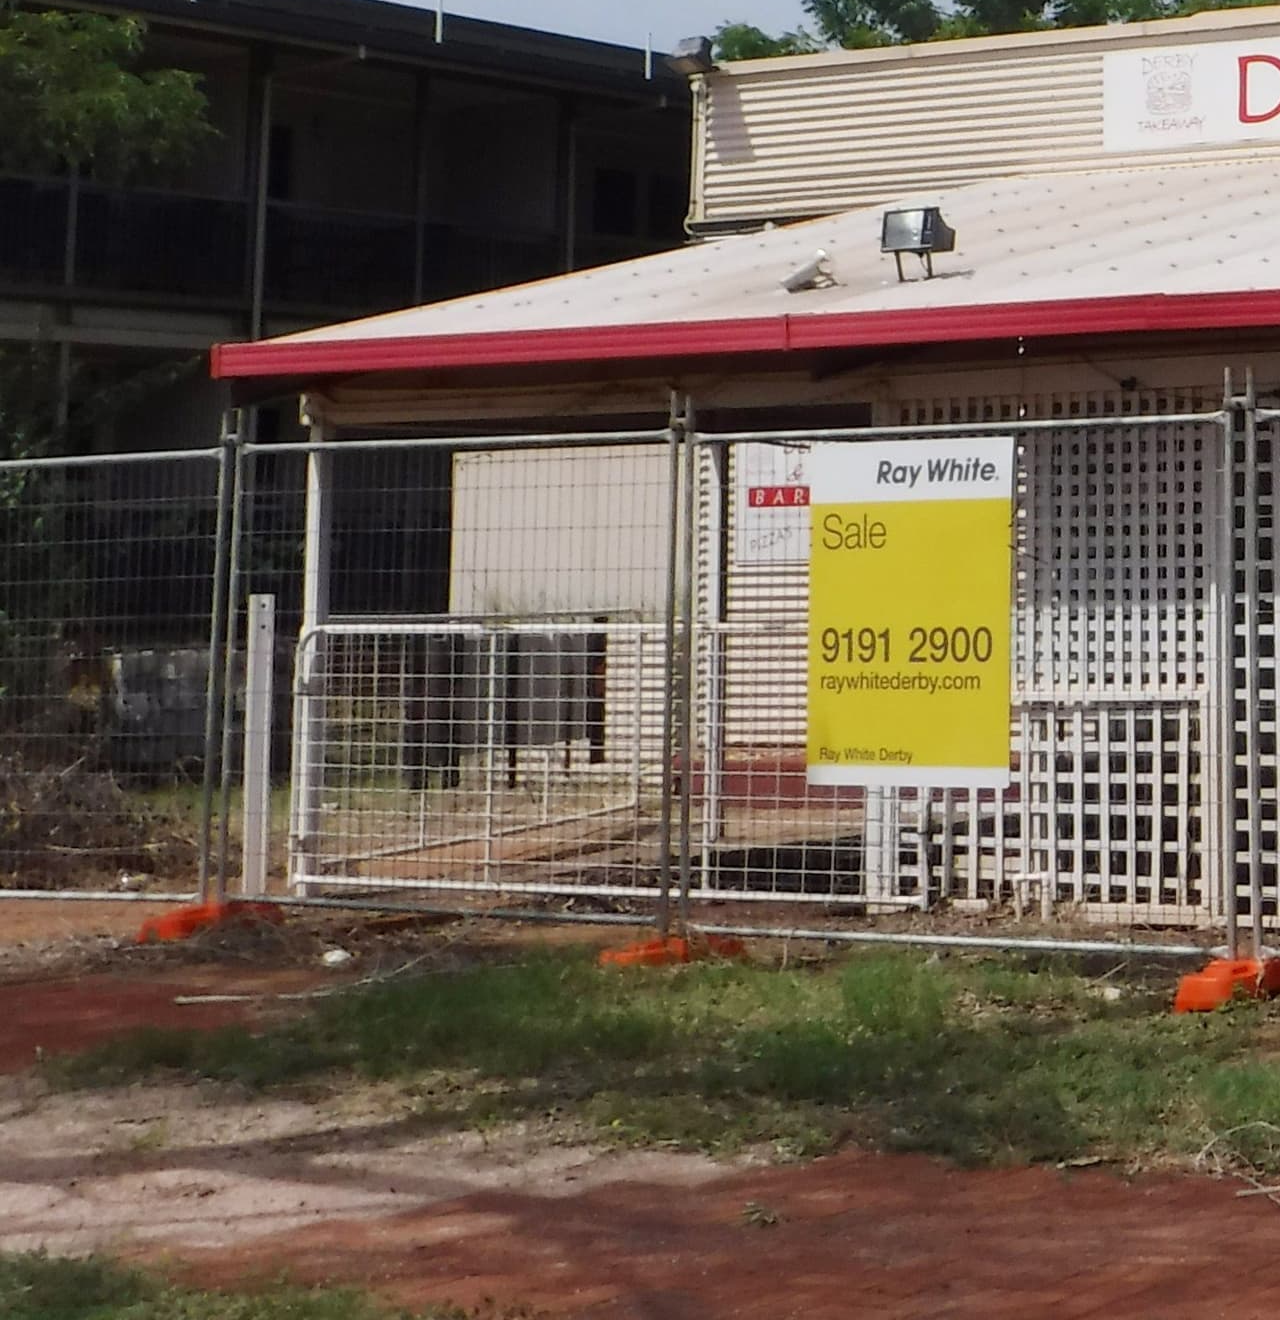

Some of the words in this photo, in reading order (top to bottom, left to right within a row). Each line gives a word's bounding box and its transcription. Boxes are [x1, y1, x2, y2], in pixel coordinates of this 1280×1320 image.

[1136, 114, 1207, 133] TAKEAWAY
[876, 460, 923, 489] Ray
[822, 512, 887, 551] Sale
[821, 626, 891, 663] 9191
[908, 626, 993, 663] 2900
[819, 671, 981, 695] raywhitederby.com
[819, 746, 841, 764] Ray
[843, 747, 876, 761] White
[879, 747, 913, 765] Derby
